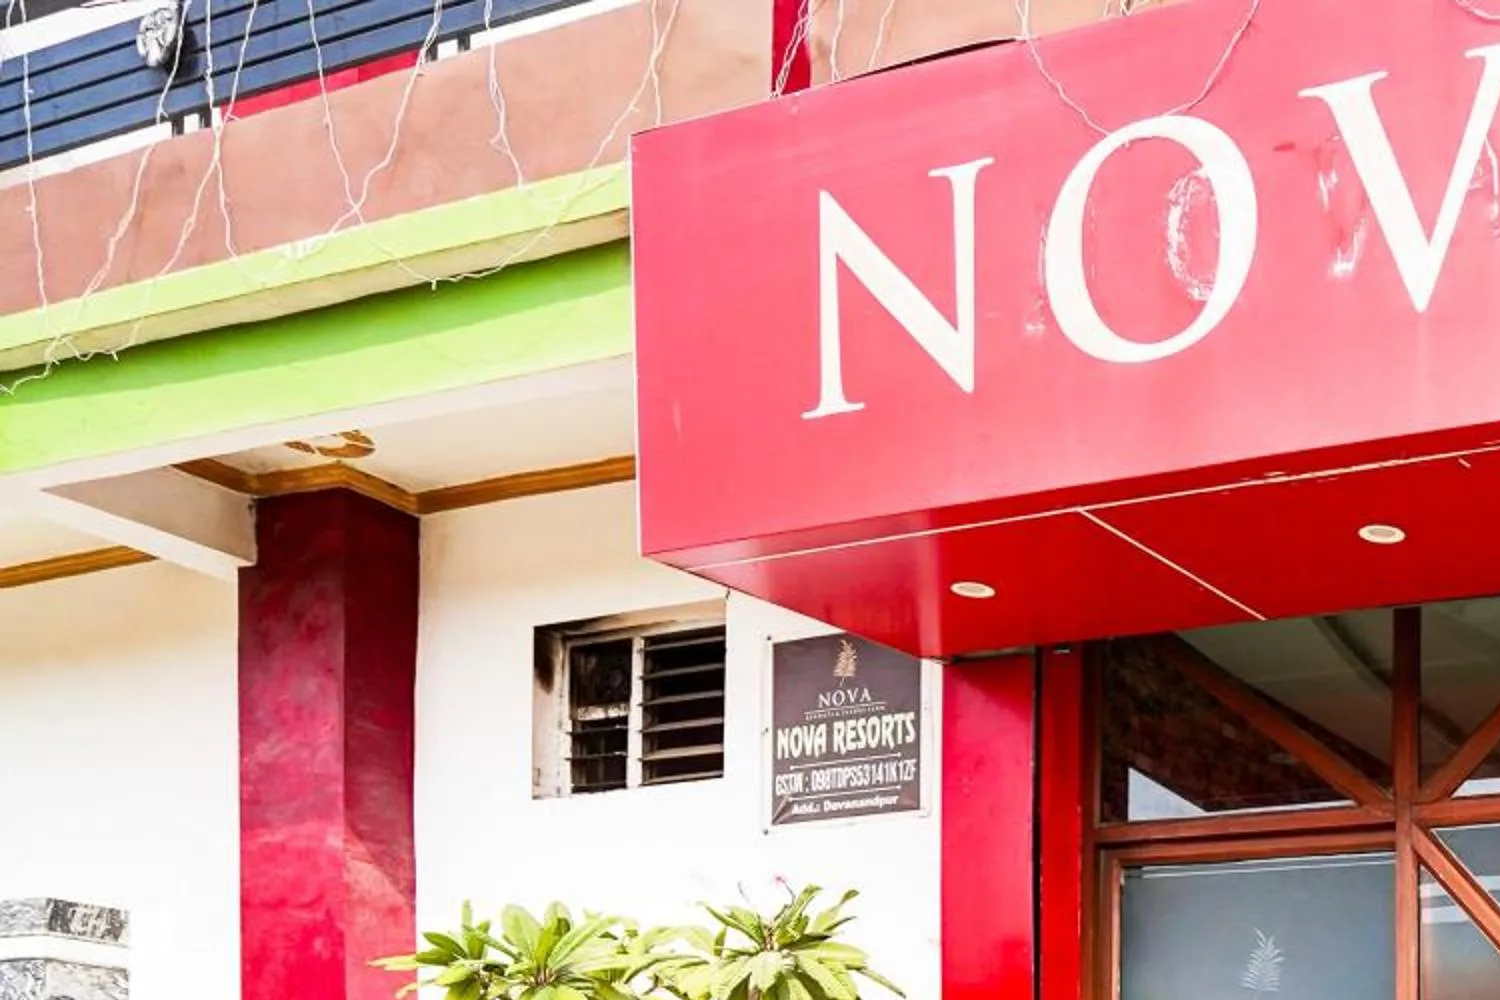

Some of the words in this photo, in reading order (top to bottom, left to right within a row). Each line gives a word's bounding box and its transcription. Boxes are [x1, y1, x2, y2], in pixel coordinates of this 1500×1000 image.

[818, 687, 872, 708] NOVA
[777, 723, 828, 760] NOVA
[832, 712, 917, 756] RESORTS
